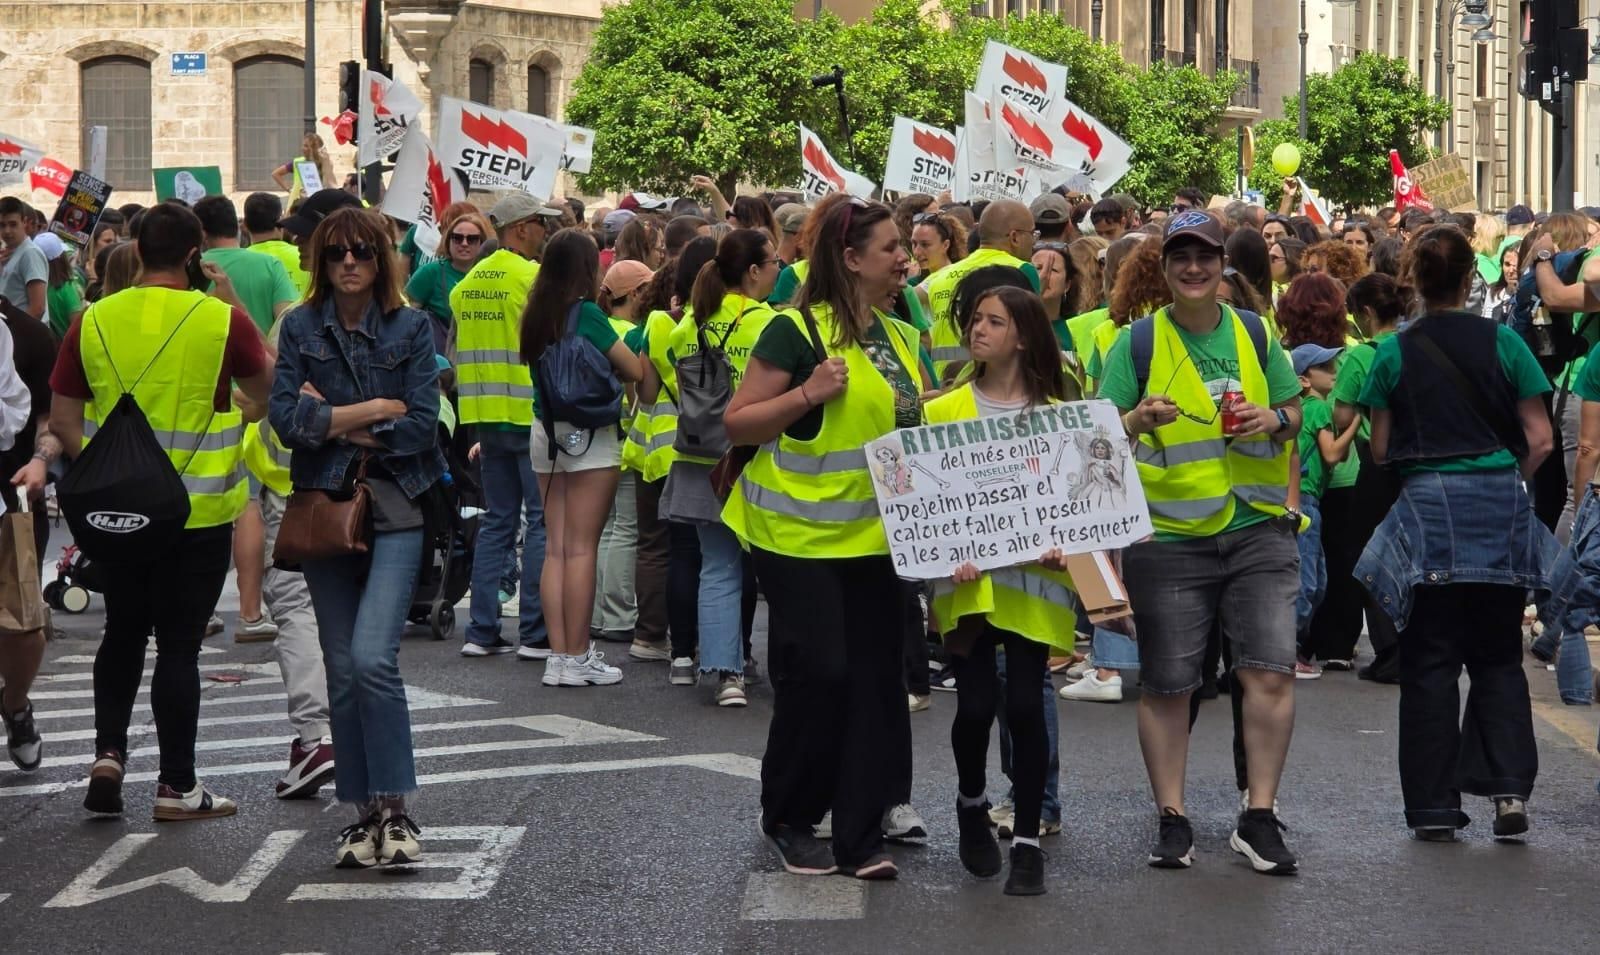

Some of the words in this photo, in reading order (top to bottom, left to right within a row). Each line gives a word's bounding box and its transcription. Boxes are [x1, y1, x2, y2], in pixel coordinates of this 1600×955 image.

[459, 148, 535, 181] STEPV
[473, 270, 507, 279] DOCENT
[461, 290, 510, 301] TREBALLANT
[461, 311, 471, 320] EN
[900, 405, 1093, 456] RITAMISSATGE
[941, 450, 966, 470] del
[971, 445, 1005, 465] més
[1009, 436, 1050, 459] enllà
[965, 463, 1026, 480] CONSELLERA
[965, 483, 1029, 512] passar
[1037, 475, 1054, 495] el
[93, 514, 141, 528] HJC
[893, 517, 961, 542] caloret
[964, 513, 1016, 536] faller
[1021, 506, 1029, 526] i
[896, 552, 908, 568] a
[912, 545, 940, 564] les
[949, 540, 998, 563] aules
[1007, 532, 1043, 553] aire
